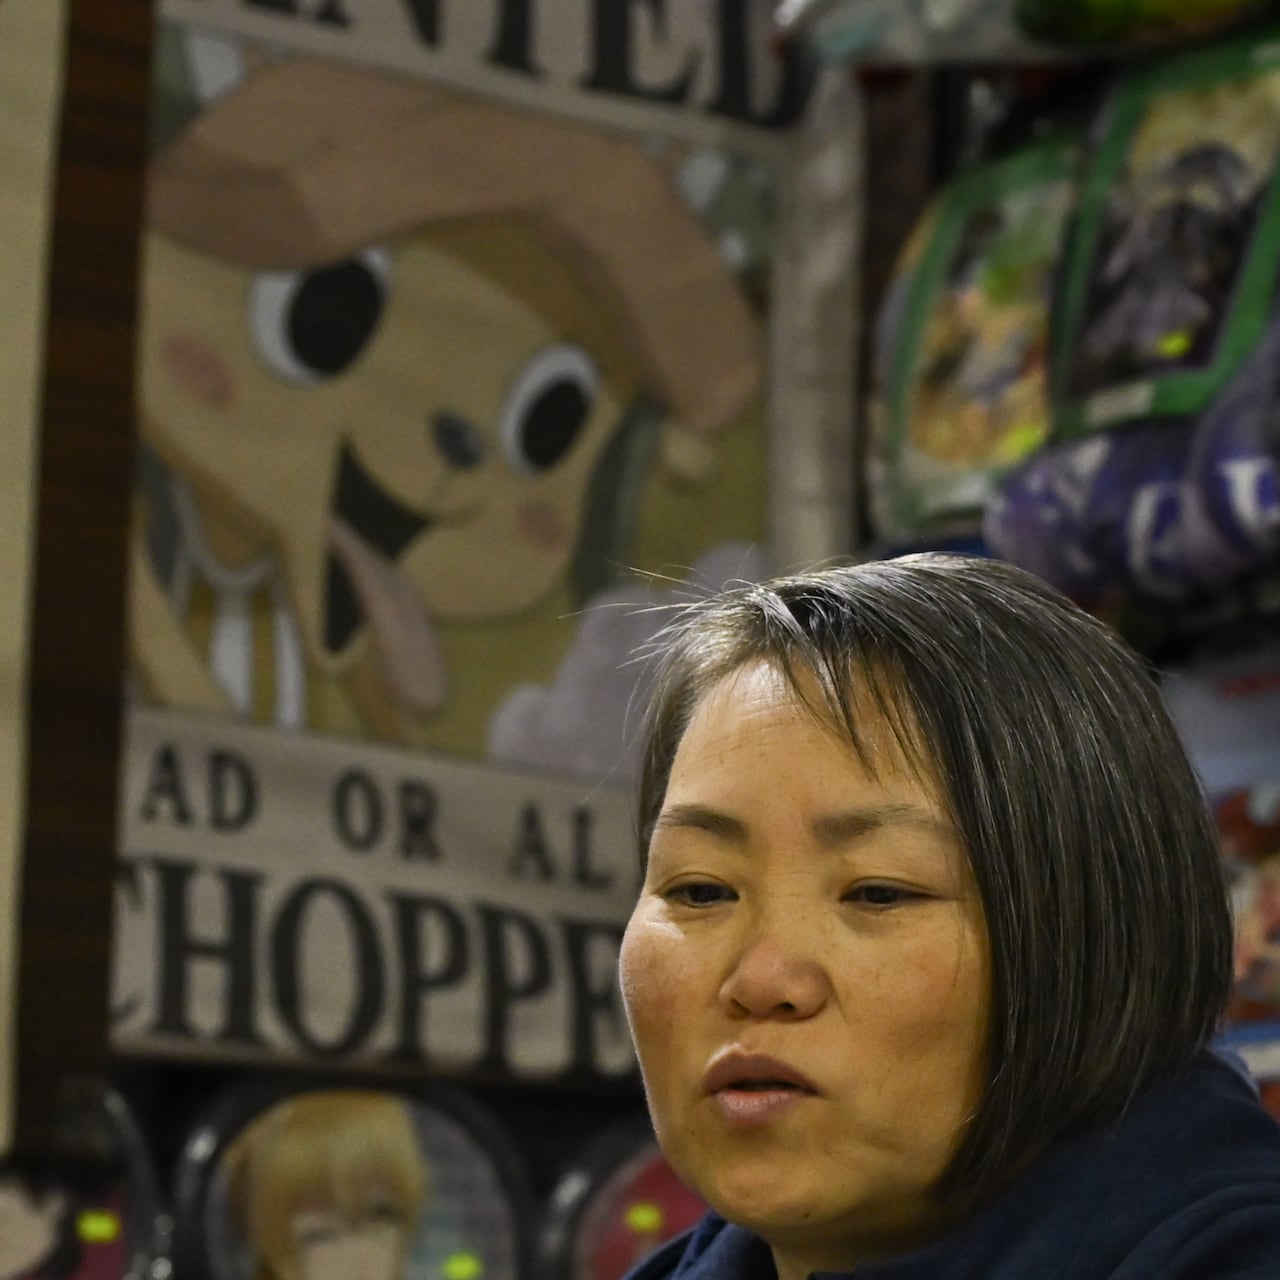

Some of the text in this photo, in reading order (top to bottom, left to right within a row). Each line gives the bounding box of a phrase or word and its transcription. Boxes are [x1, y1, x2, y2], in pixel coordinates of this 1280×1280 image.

[140, 743, 611, 888] AD OR AL
